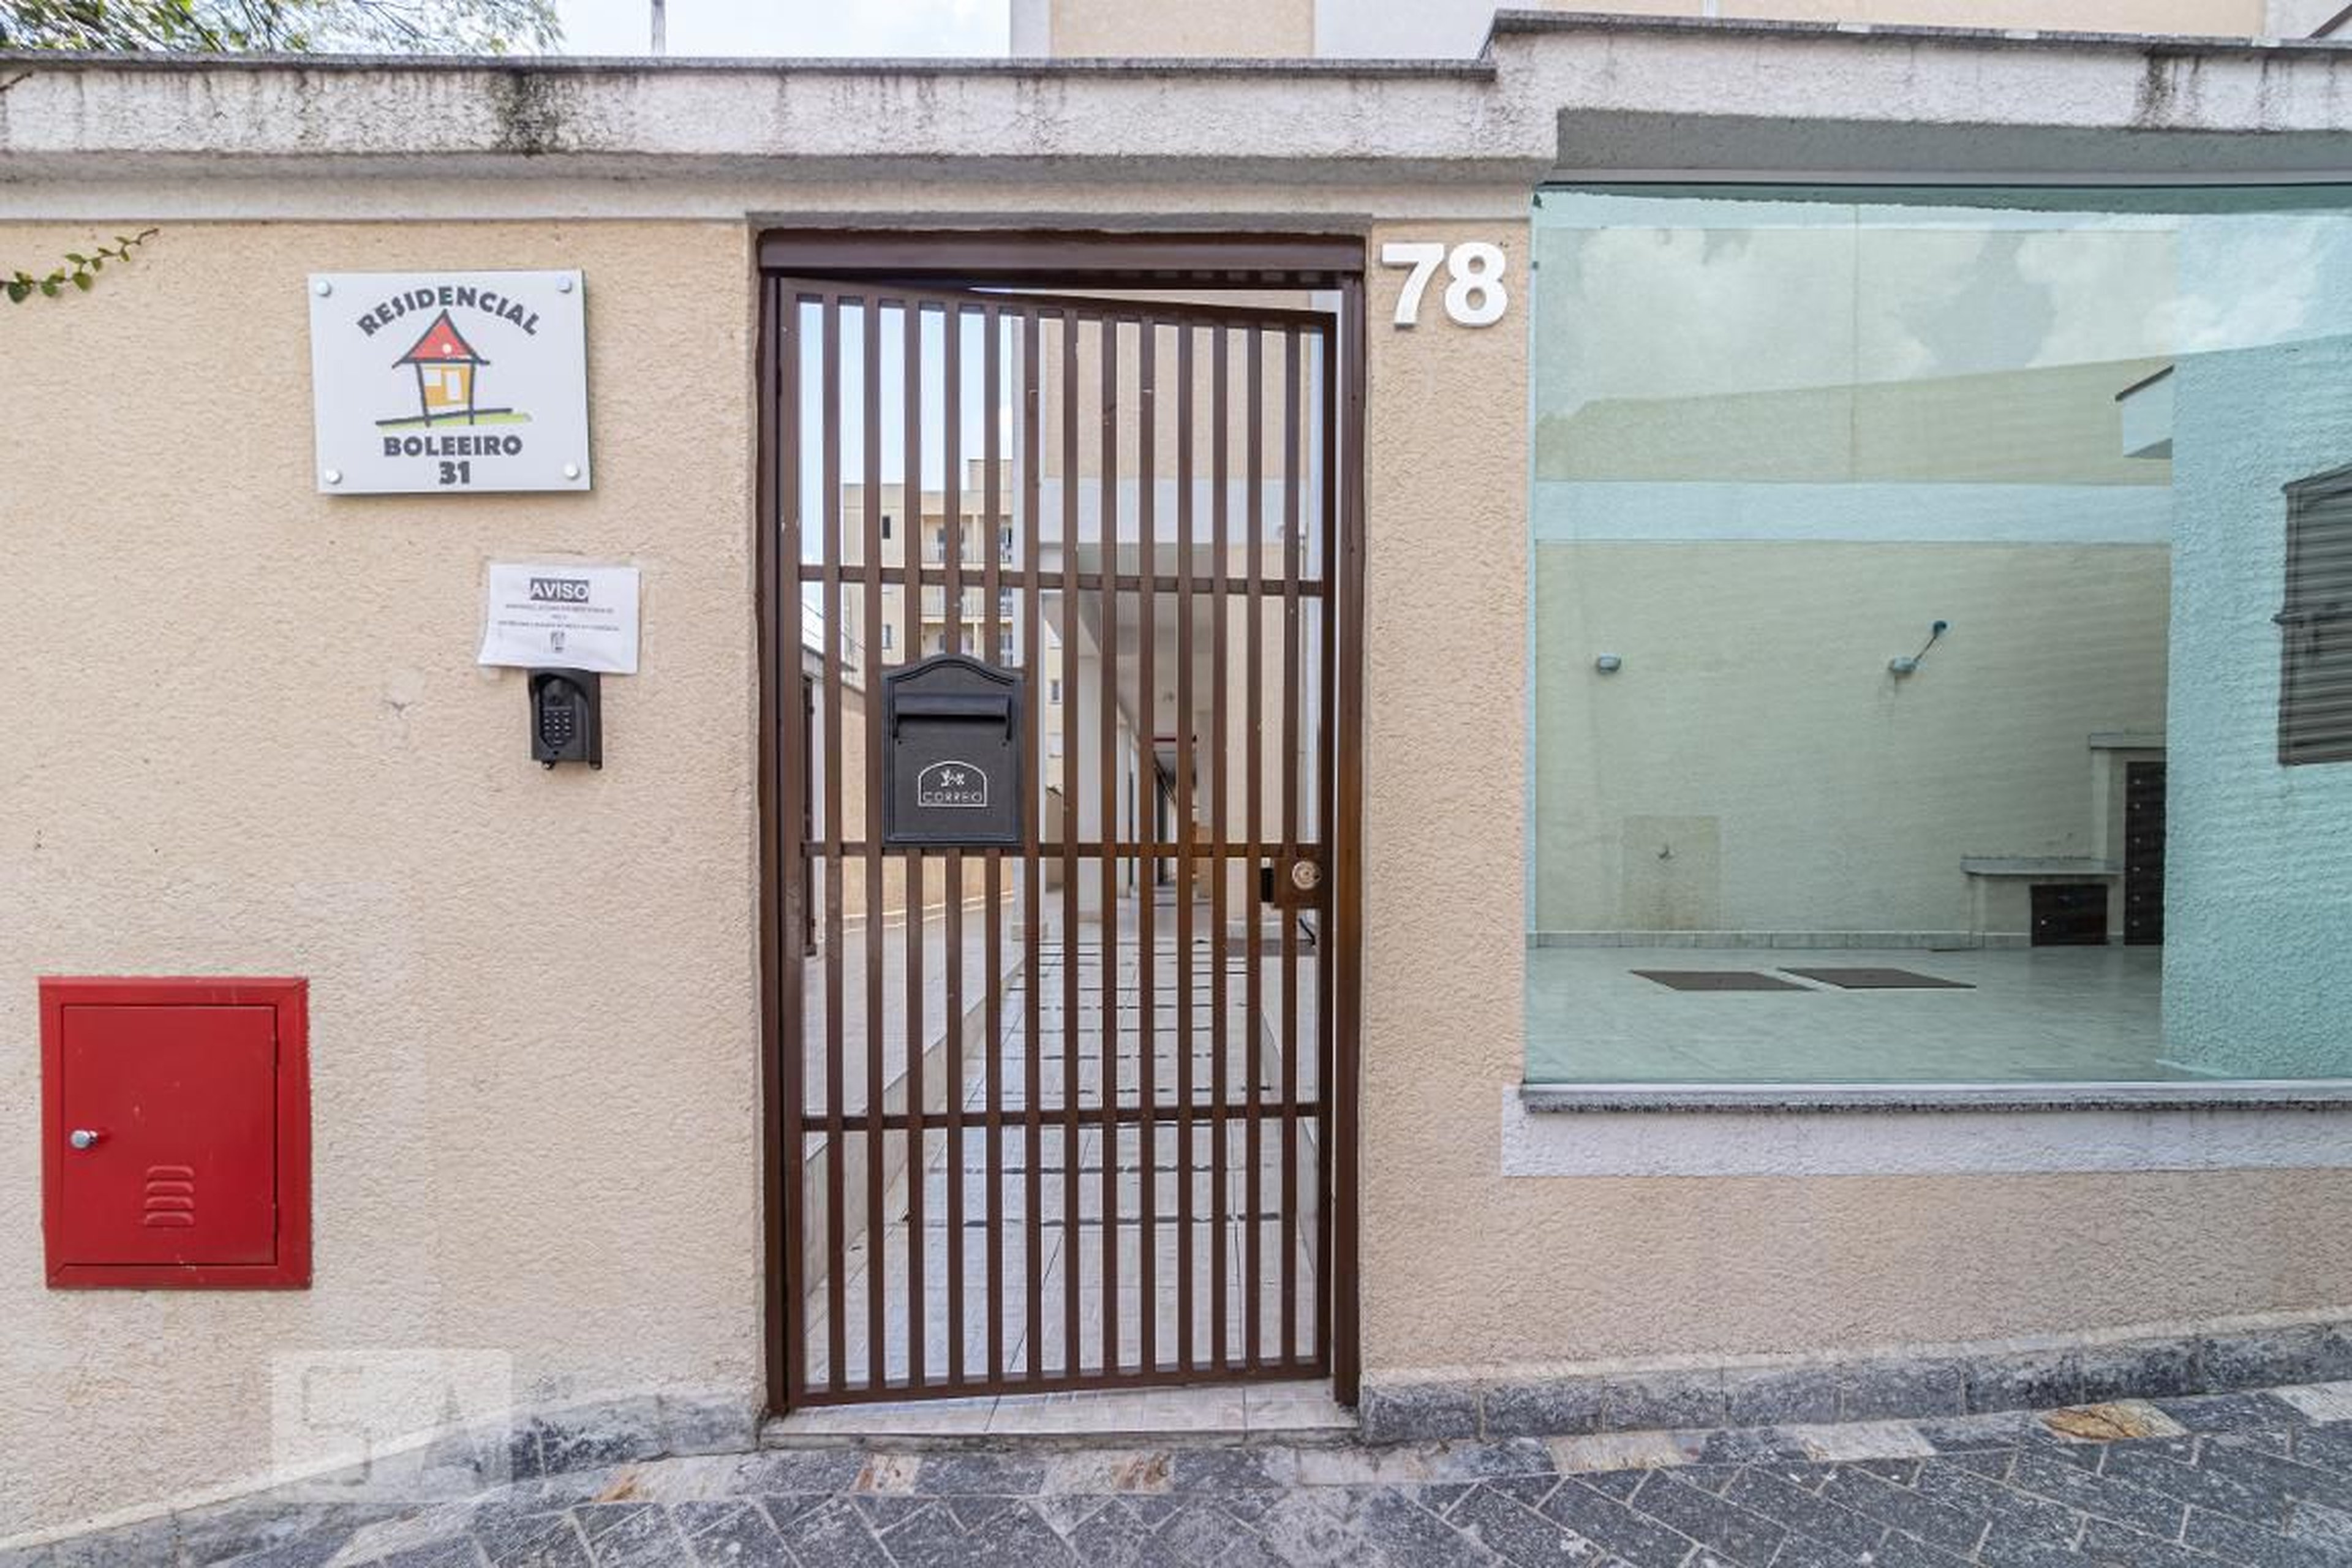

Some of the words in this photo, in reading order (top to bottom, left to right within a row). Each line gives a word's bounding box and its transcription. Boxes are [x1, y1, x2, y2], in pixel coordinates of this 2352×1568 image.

[1382, 243, 1507, 326] 78
[356, 286, 540, 336] RESIDENCIAL
[383, 435, 522, 456] BOLEEIRO
[439, 461, 471, 484] 31
[530, 581, 589, 600] AVISO
